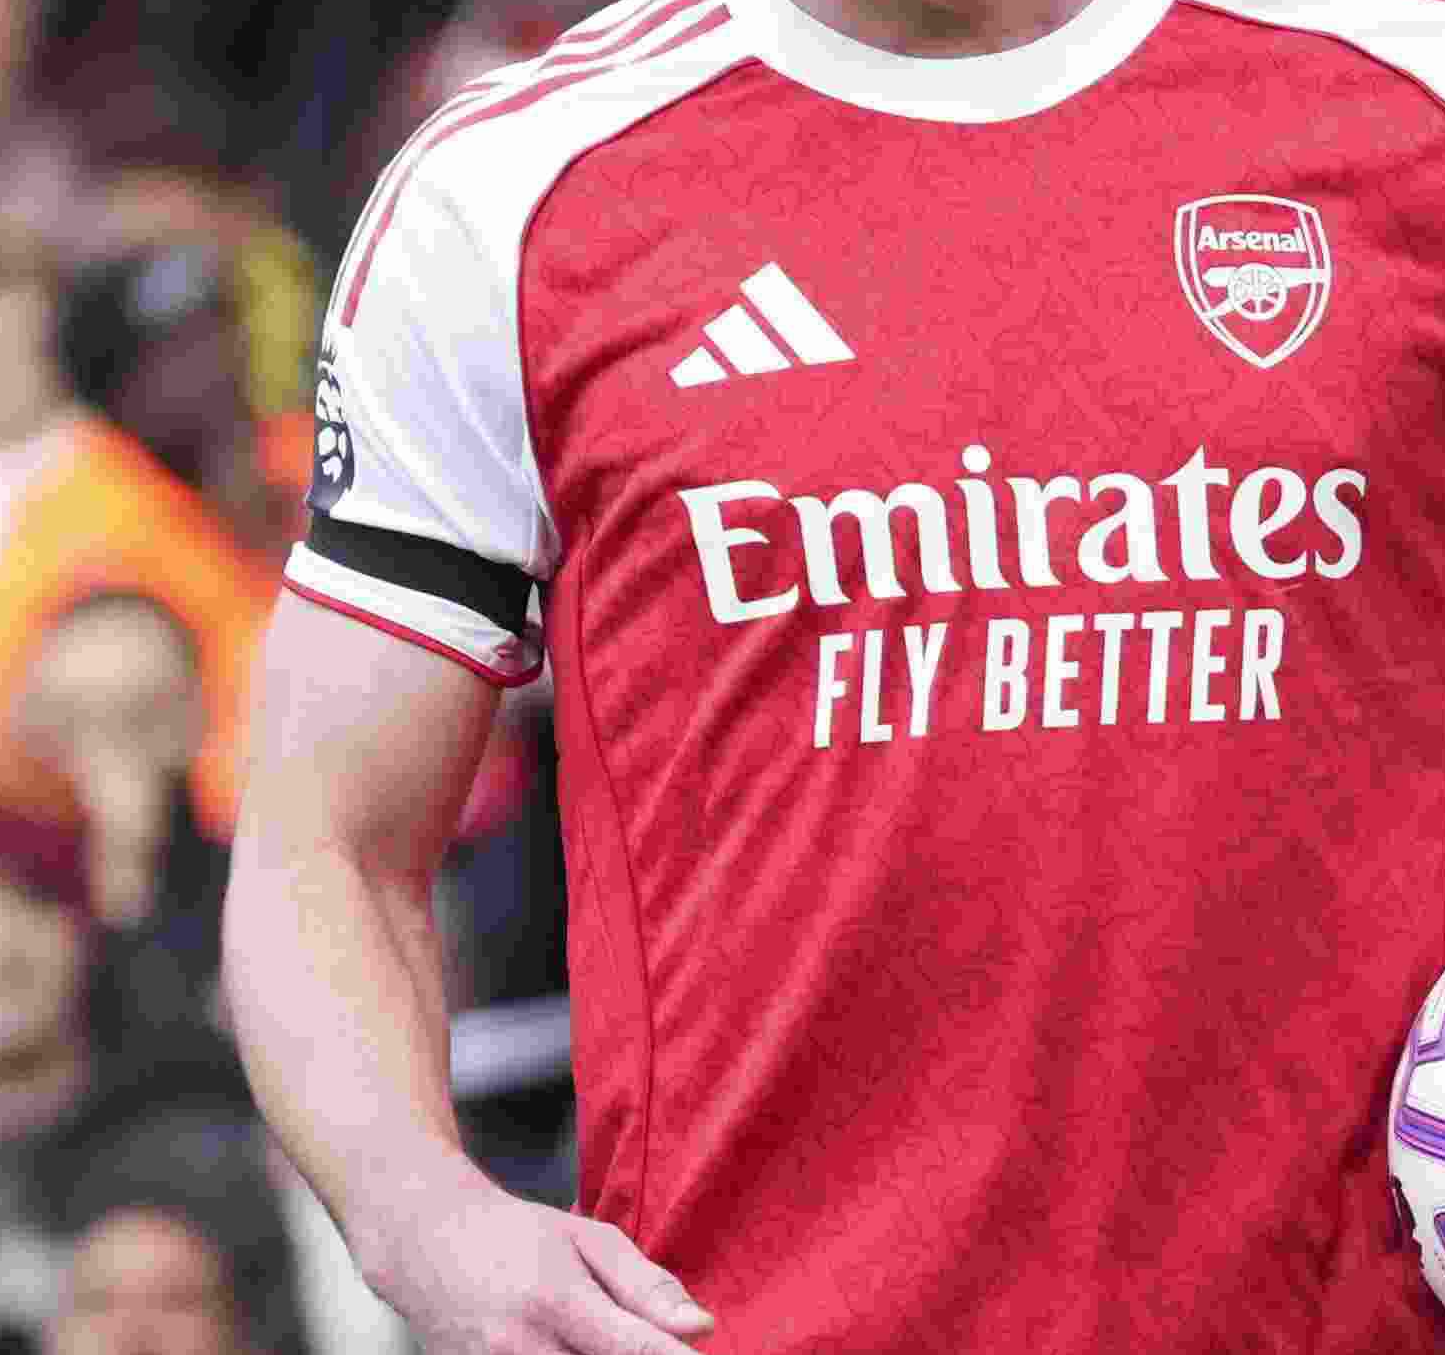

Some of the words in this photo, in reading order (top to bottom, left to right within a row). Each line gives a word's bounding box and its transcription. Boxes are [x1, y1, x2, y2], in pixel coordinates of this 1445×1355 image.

[1197, 225, 1307, 253] Arsenal
[677, 445, 1368, 625] Emirates
[812, 623, 951, 750] FLY
[981, 609, 1286, 732] BETTER
